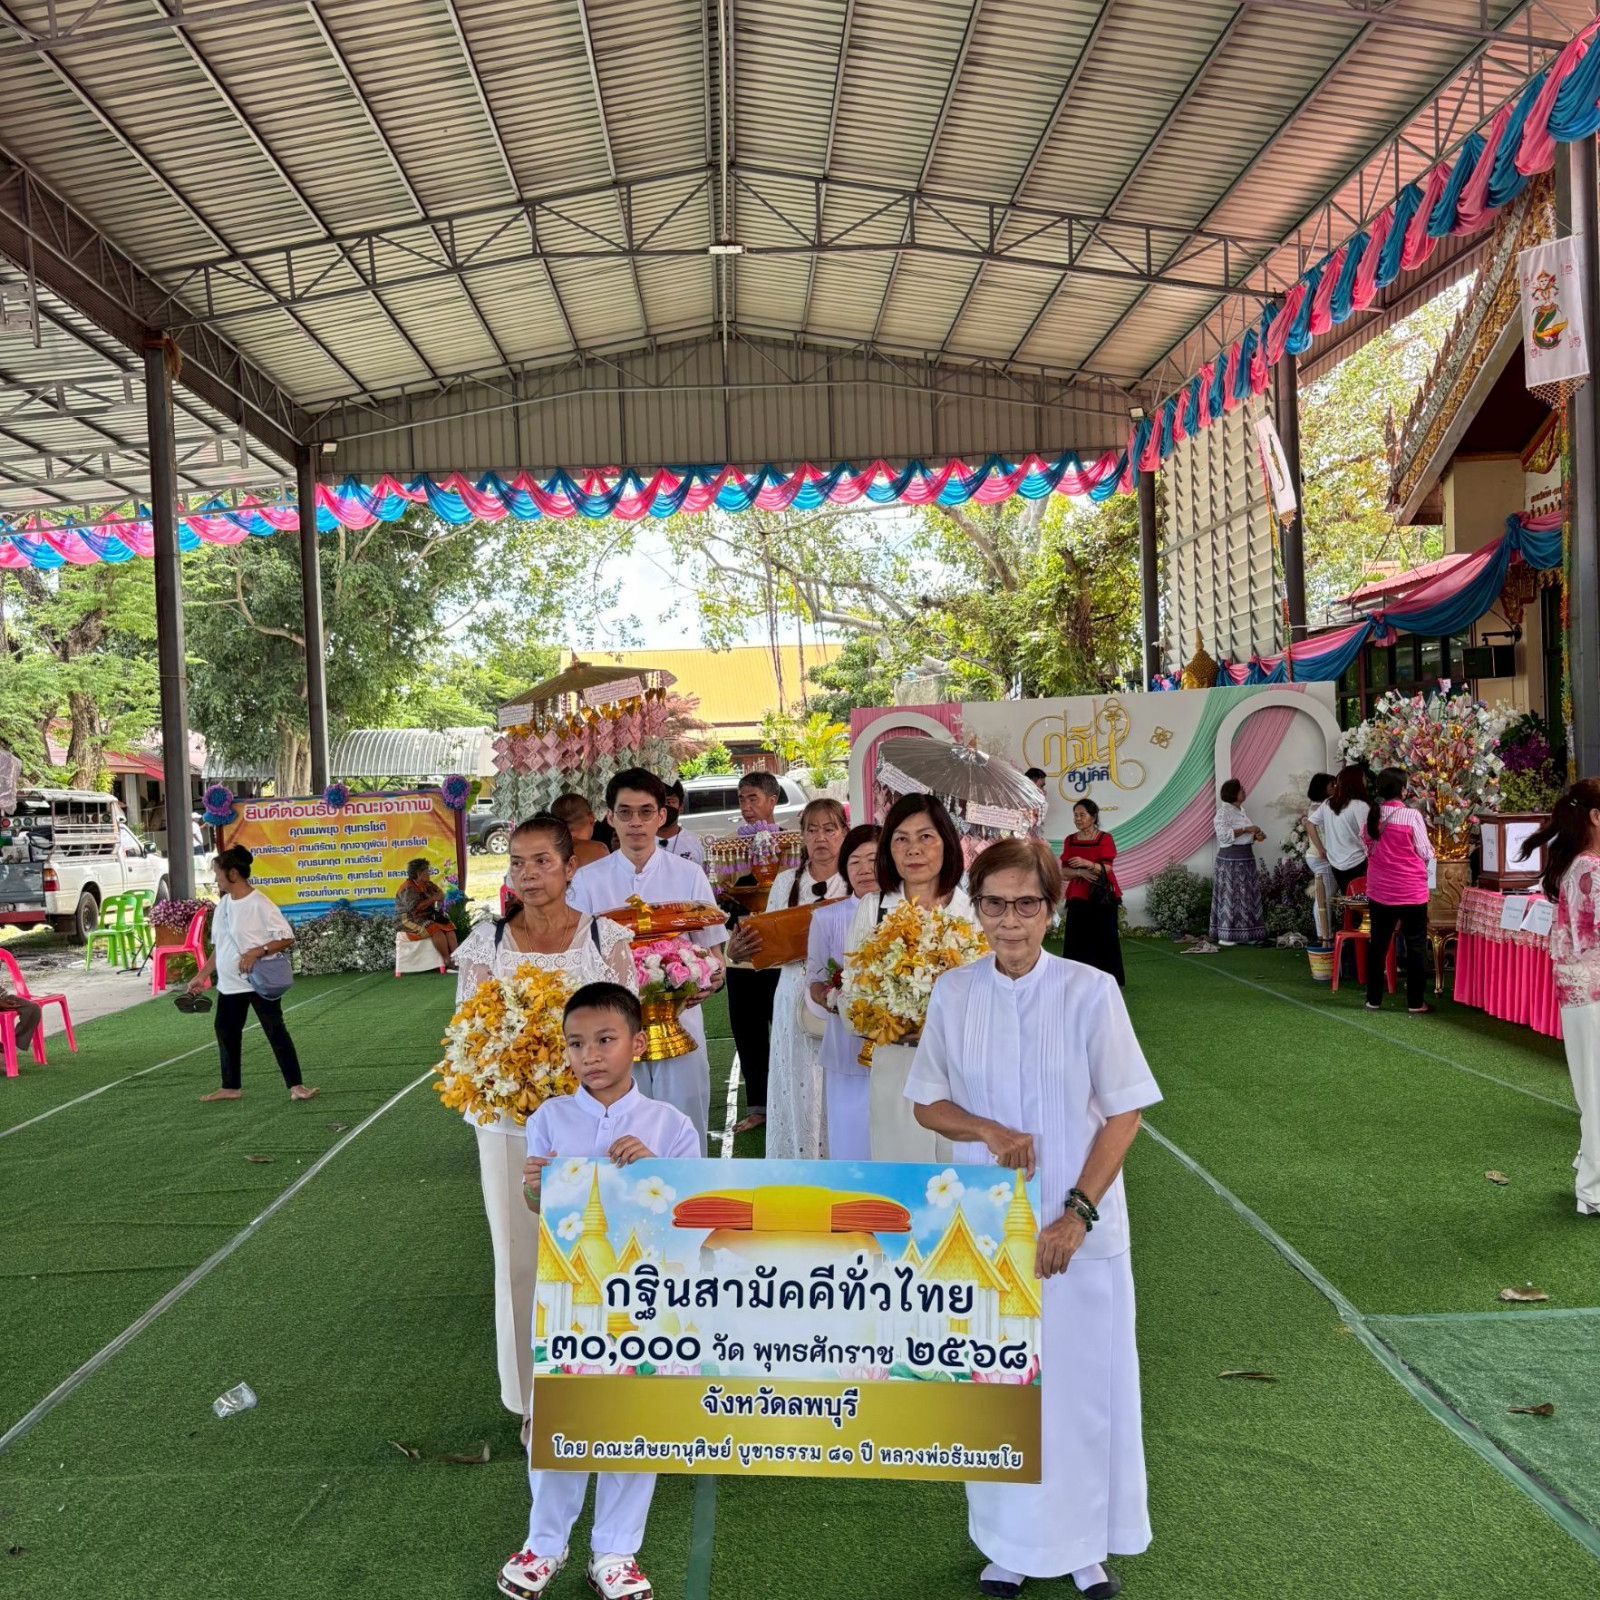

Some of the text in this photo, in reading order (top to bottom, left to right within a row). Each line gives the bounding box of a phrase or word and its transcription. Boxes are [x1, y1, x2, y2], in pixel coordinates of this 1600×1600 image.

[1067, 766, 1110, 793] สามัคคี
[344, 799, 432, 815] คณะเจาภาพ
[606, 1256, 975, 1320] กฐินสามัคคีทั่วไทย
[551, 1334, 1028, 1373] ๓๐,๐๐๐ วัด พุทธศักราช ๒๕๖๘
[701, 1386, 860, 1427] จังหวัดลพบุรี
[553, 1434, 1023, 1469] โดย คณะศิษยานุศิษย์ บูชาธรรม ๘๑ ปี หลวงพ่อธัมมชโย
